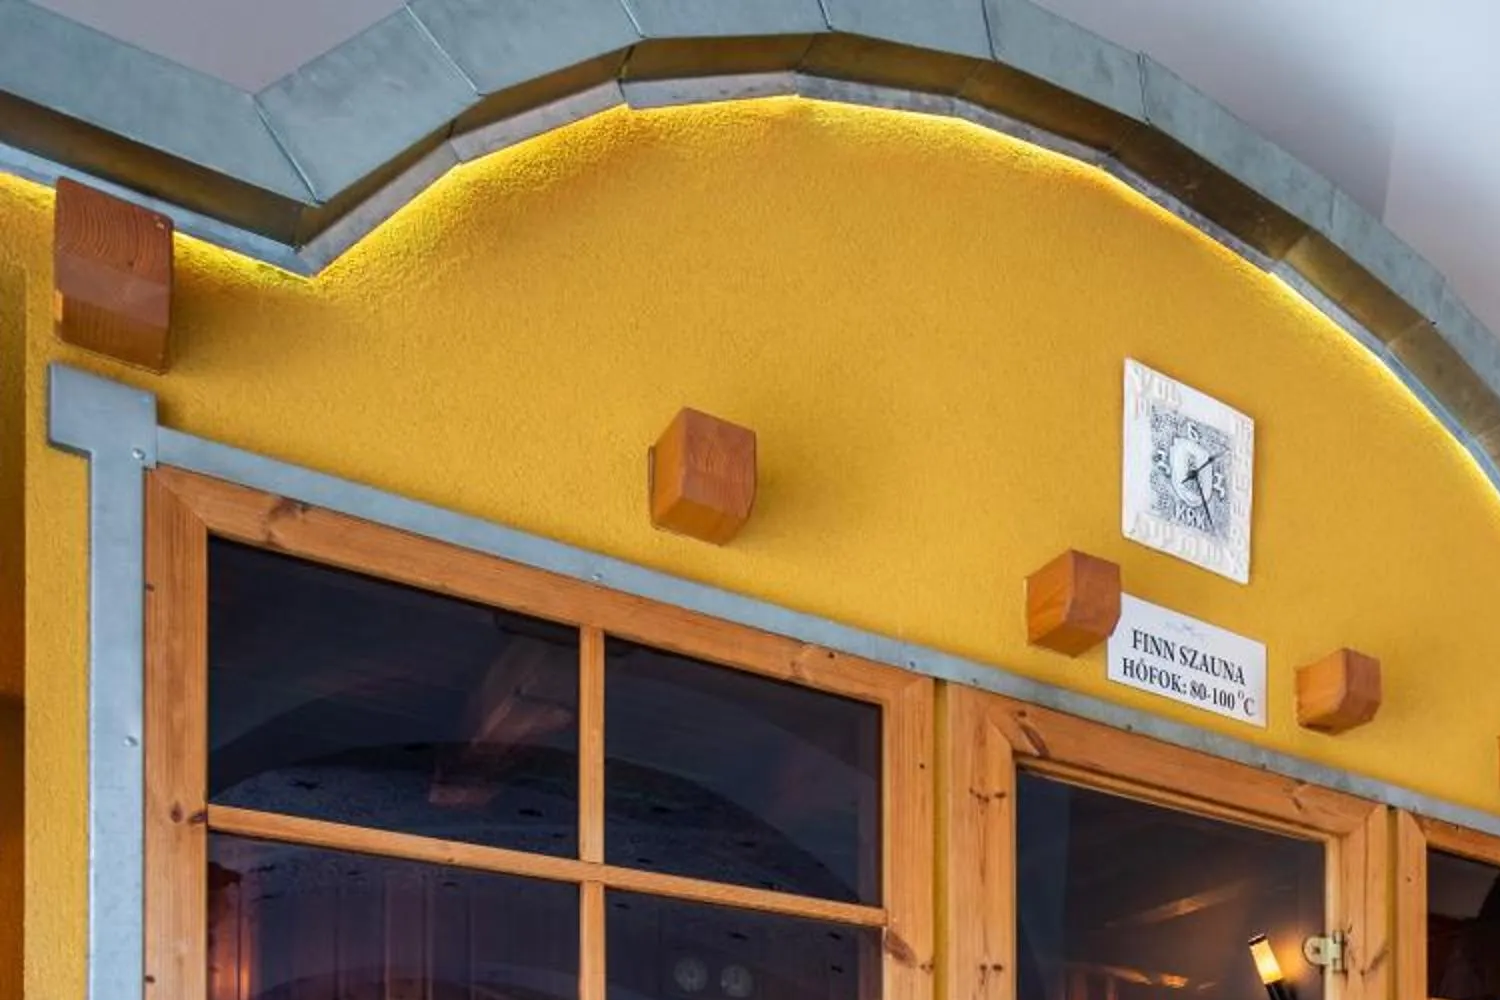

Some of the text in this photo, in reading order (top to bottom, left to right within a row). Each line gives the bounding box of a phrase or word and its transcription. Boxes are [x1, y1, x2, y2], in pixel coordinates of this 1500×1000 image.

[1131, 628, 1247, 687] FINN SZAUNA
[1189, 679, 1236, 712] 80-100
